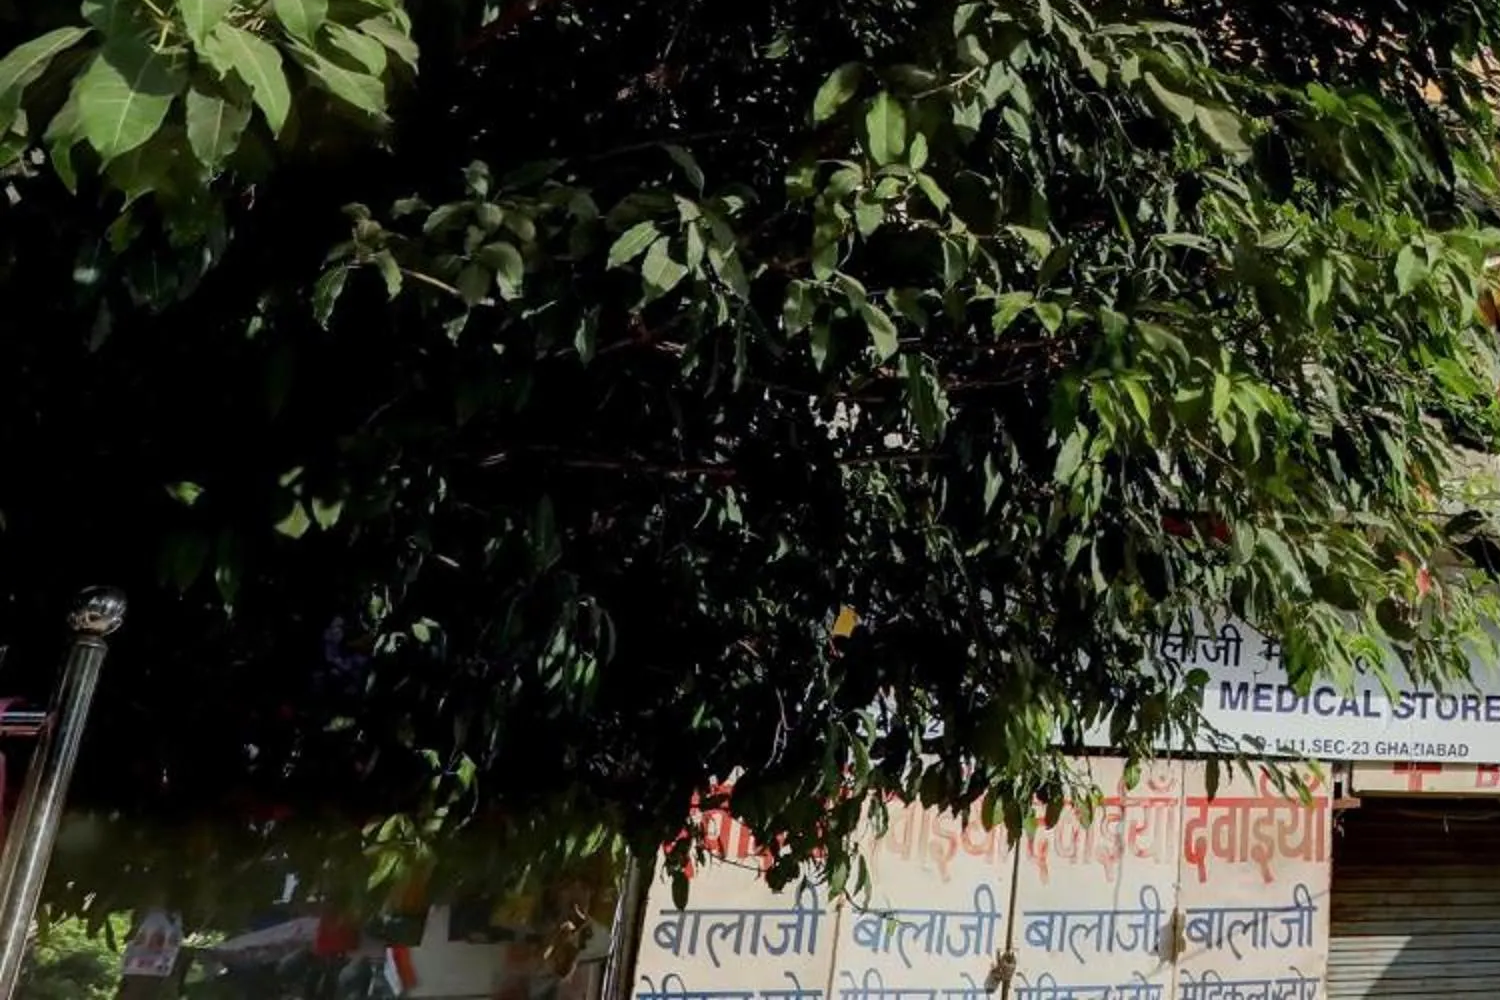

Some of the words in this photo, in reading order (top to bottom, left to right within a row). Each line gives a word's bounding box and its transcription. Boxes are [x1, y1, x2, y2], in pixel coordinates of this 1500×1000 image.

[1219, 680, 1381, 719] MEDICAL
[1375, 741, 1469, 757] GHAZIABAD
[653, 877, 825, 968] बालाजी
[852, 884, 1002, 968] बालाजी
[1023, 884, 1166, 964] बालाजी
[1186, 883, 1318, 960] बालाजी
